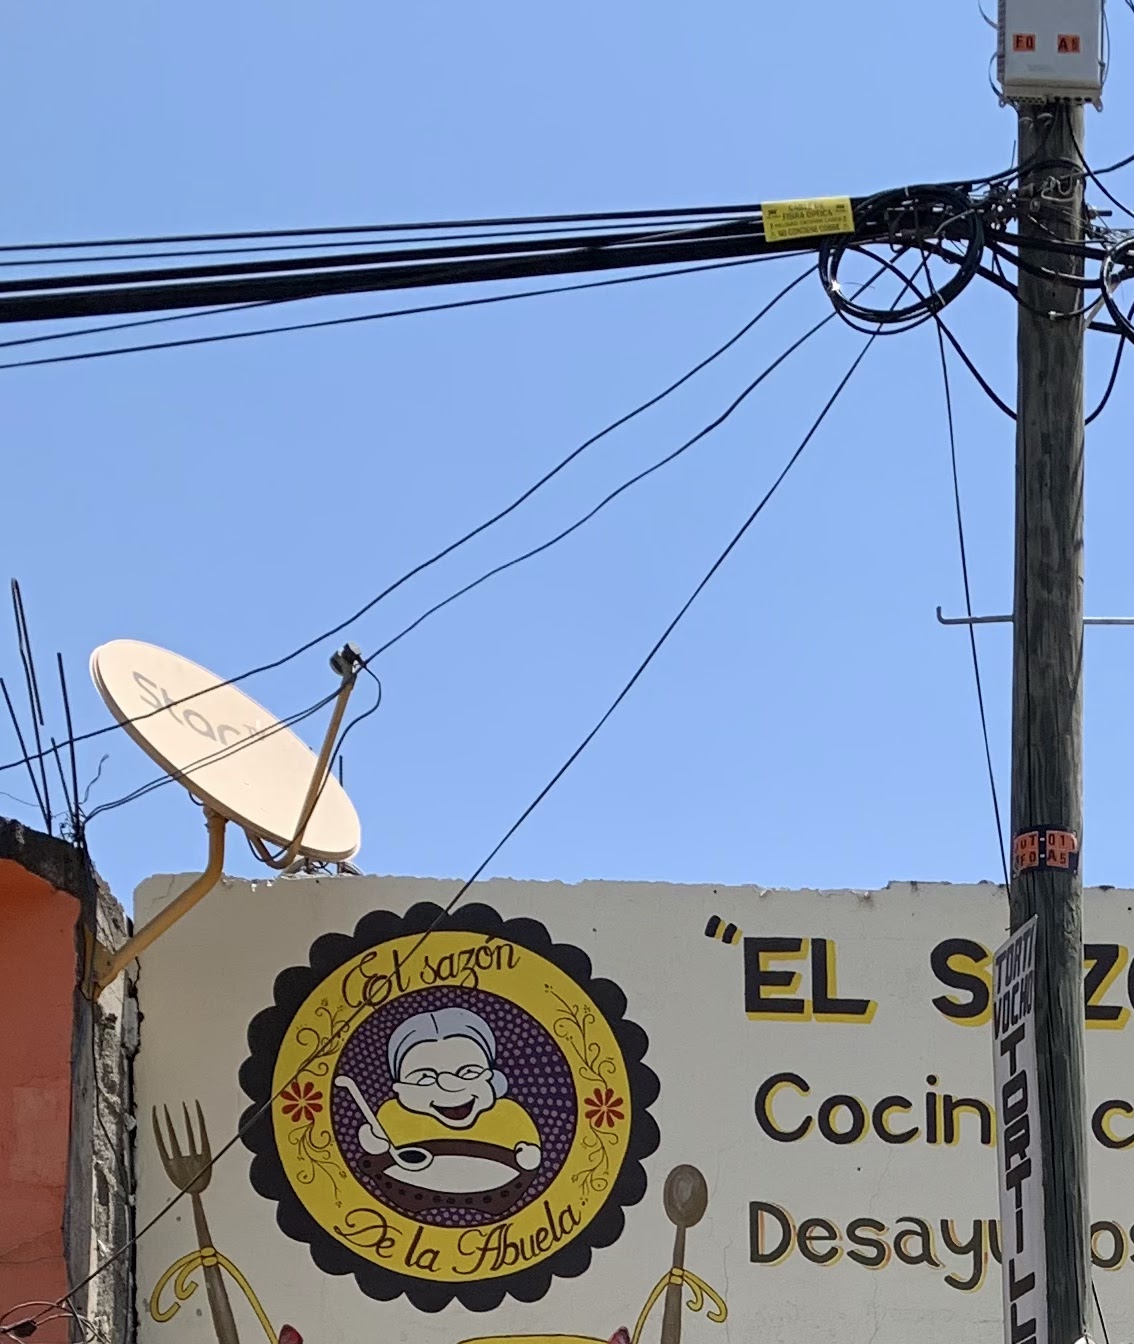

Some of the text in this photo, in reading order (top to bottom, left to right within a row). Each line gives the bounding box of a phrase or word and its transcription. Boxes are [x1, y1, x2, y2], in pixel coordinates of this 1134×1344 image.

[342, 935, 521, 1010] El sazón
[755, 1072, 998, 1145] Cocin
[333, 1200, 582, 1275] De la Abuela
